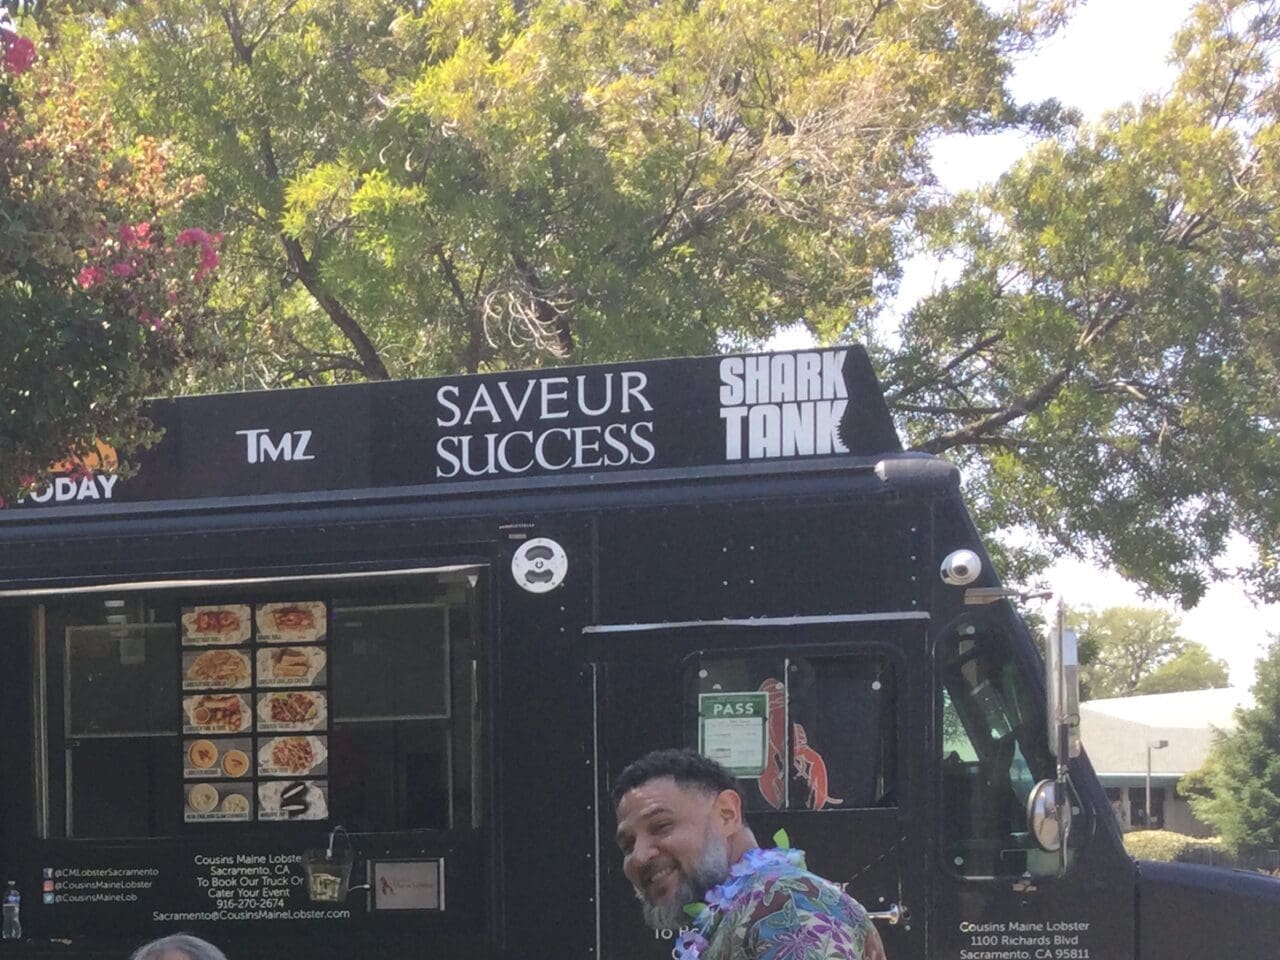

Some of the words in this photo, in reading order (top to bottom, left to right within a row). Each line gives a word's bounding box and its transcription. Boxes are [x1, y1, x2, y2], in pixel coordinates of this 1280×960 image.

[720, 350, 849, 406] SHARK
[436, 371, 654, 427] SAVEUR
[720, 399, 850, 460] TANK
[235, 428, 315, 463] TMZ
[436, 422, 655, 478] SUCCESS
[18, 475, 118, 504] ODAY
[713, 703, 754, 716] PASS
[194, 855, 234, 865] Cousins
[236, 854, 266, 864] Maine
[269, 854, 302, 863] Lobste
[275, 865, 290, 874] CA
[196, 877, 209, 887] To
[212, 877, 237, 887] Book
[240, 877, 259, 886] Our
[262, 876, 288, 886] Truck
[291, 876, 304, 886] Or
[208, 888, 234, 898] Cater
[237, 888, 259, 897] Your
[262, 888, 290, 897] Event
[216, 899, 284, 909] 916-270-2674
[153, 910, 351, 921] Sacramento@CousinsMaineLobster.com
[959, 921, 1006, 932] Cousins
[1008, 922, 1043, 931] Maine
[1047, 921, 1090, 931] Lobster
[971, 936, 998, 946] 1100
[1001, 935, 1051, 945] Richards
[1054, 935, 1079, 945] Blvd
[1035, 949, 1052, 959] CA
[1055, 949, 1090, 959] 95811
